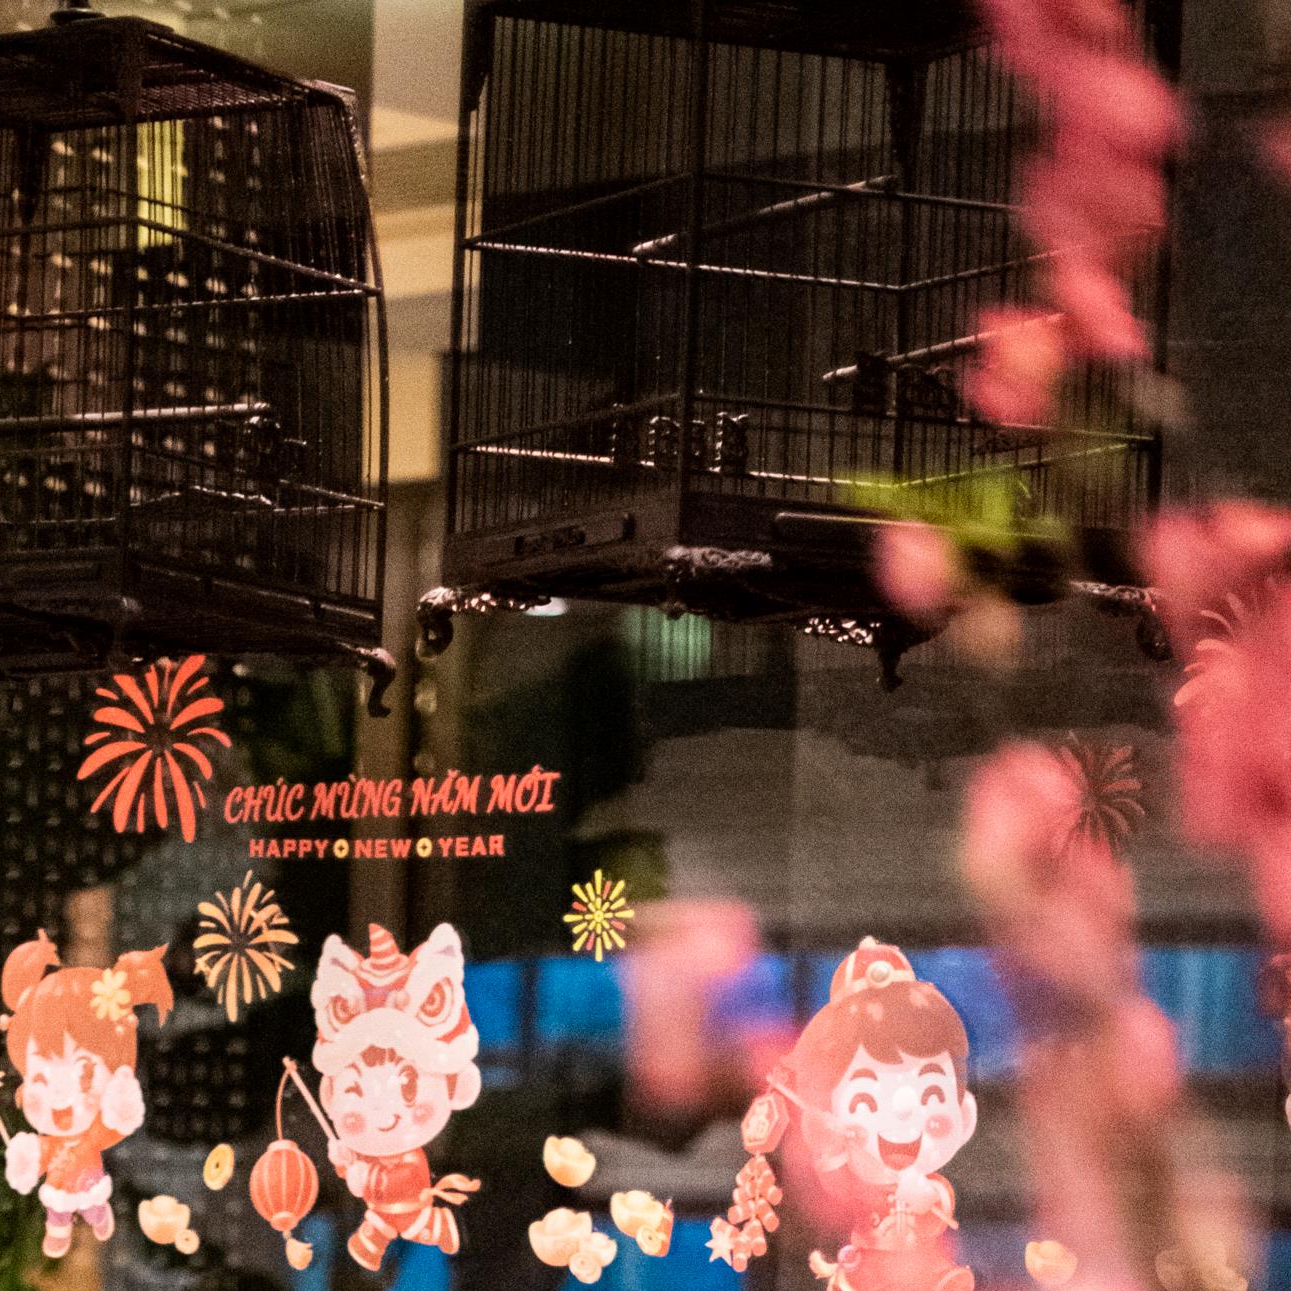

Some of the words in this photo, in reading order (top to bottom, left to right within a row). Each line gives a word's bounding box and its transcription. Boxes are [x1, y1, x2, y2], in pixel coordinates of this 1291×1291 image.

[223, 778, 304, 824] CHÚC
[410, 769, 481, 817] NĂM
[487, 764, 560, 813] MỚI
[249, 839, 329, 858] HAPPY
[354, 838, 412, 858] NEW
[438, 835, 505, 857] YEAR
